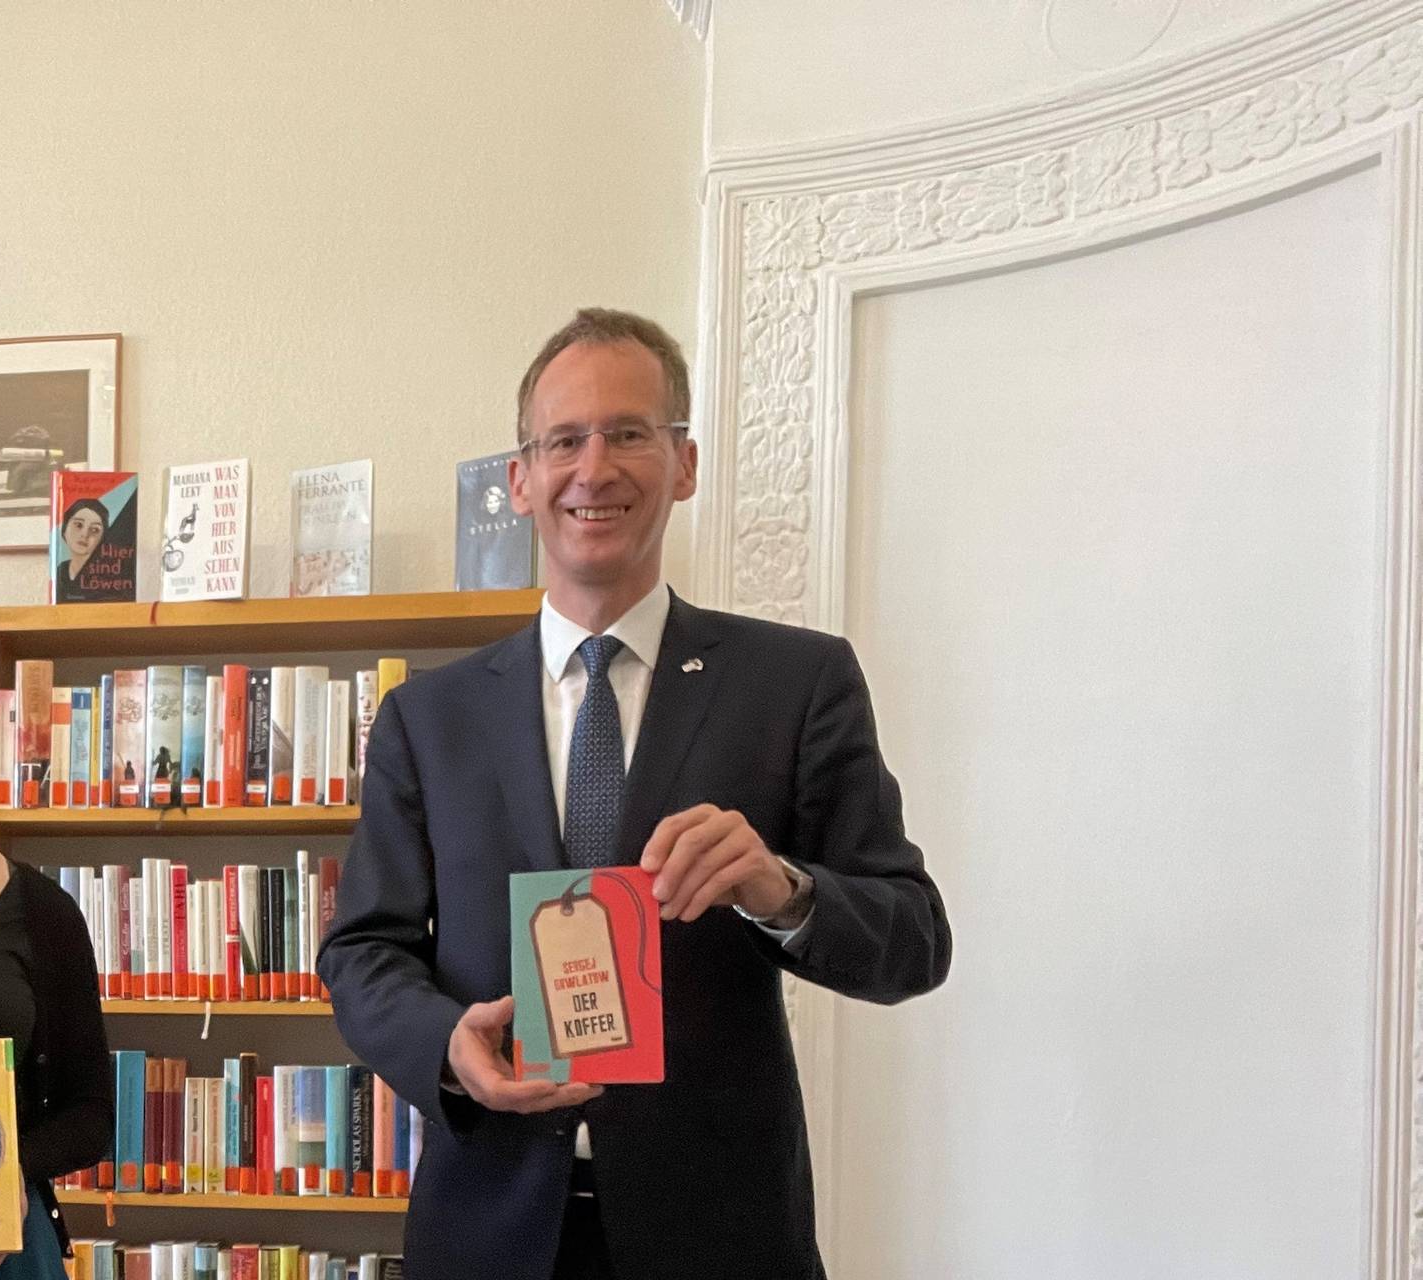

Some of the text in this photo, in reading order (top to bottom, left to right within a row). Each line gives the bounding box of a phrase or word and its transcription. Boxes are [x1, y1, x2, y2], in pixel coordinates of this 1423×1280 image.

[215, 465, 240, 481] WAS
[214, 484, 239, 499] MAN
[297, 479, 367, 499] FERRANTE
[214, 503, 236, 518] VON
[211, 521, 237, 537] HIER
[470, 518, 517, 535] STELLA
[101, 543, 134, 559] Hier
[212, 541, 234, 555] AUS
[89, 558, 121, 575] sind
[204, 557, 240, 574] SEHEN
[80, 574, 133, 591] Löwen
[206, 576, 237, 593] KANN
[572, 992, 598, 1012] DER
[564, 1013, 616, 1038] KOFFER
[353, 1087, 362, 1172] NICHOLAS SPARKS
